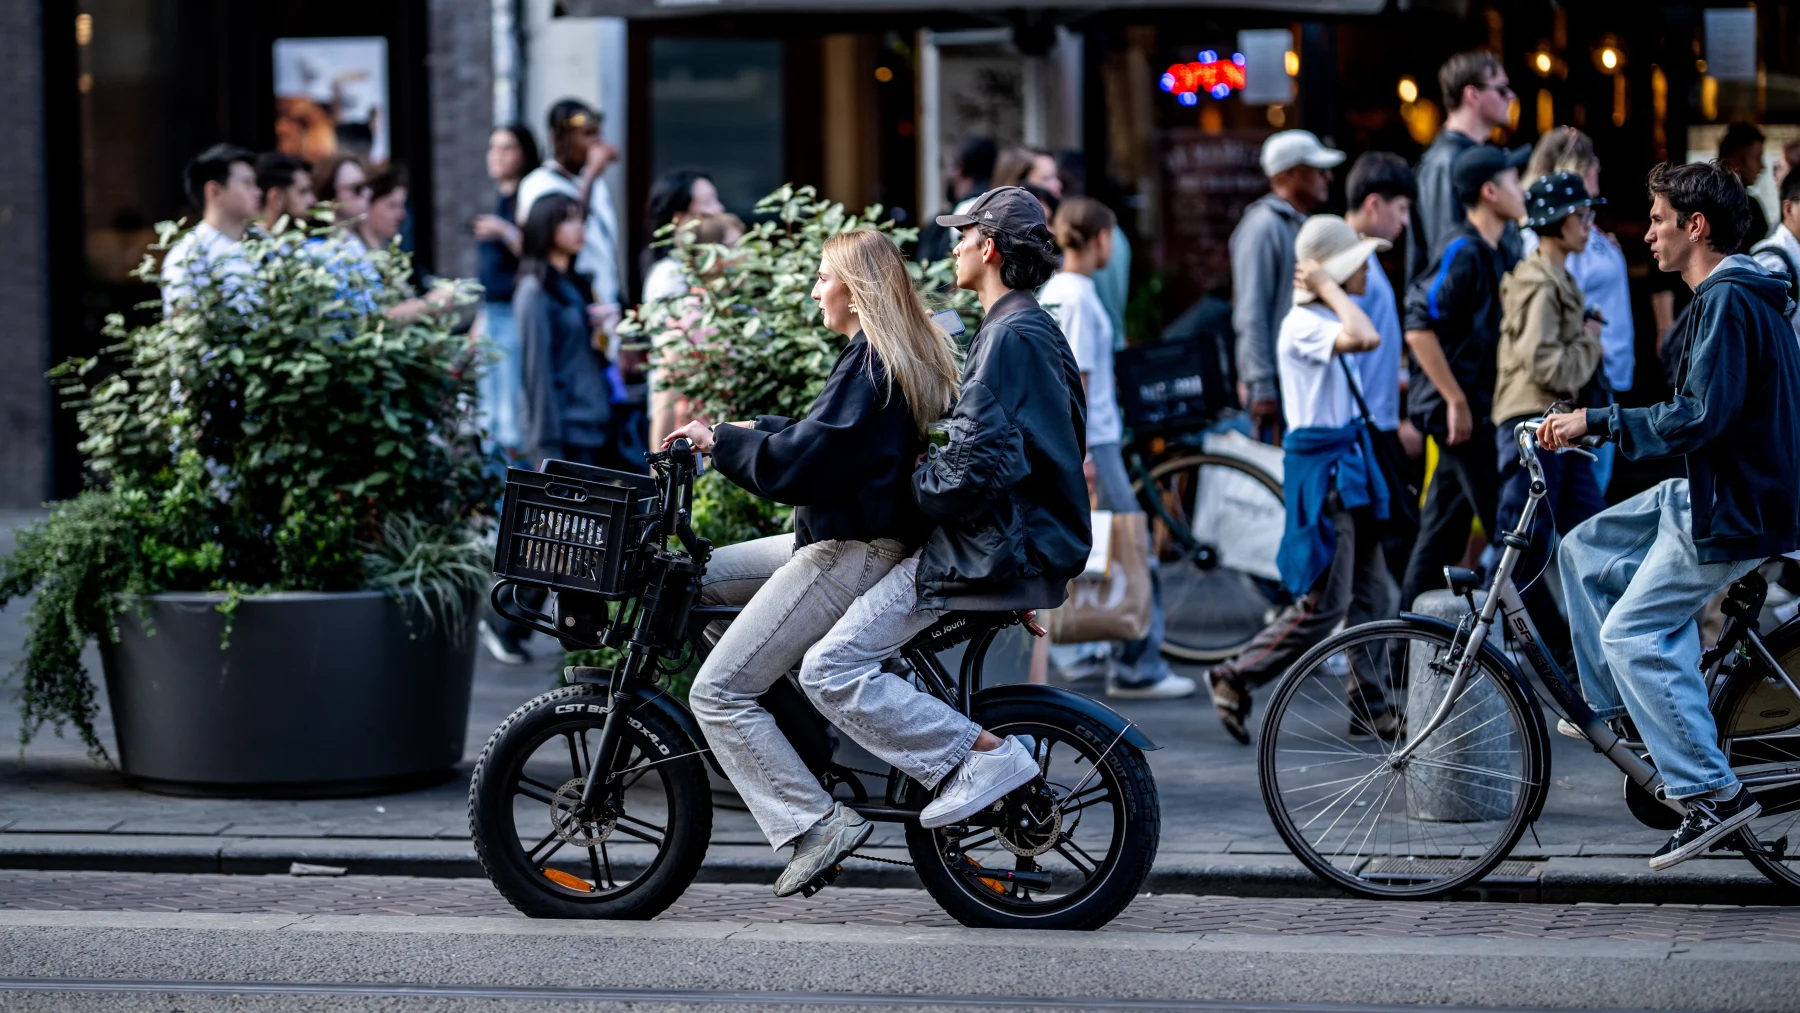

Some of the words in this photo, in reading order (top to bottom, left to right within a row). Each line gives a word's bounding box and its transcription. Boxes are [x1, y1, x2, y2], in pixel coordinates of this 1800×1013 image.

[943, 618, 966, 634] Souris
[555, 703, 585, 714] CST
[1074, 725, 1101, 744] CST
